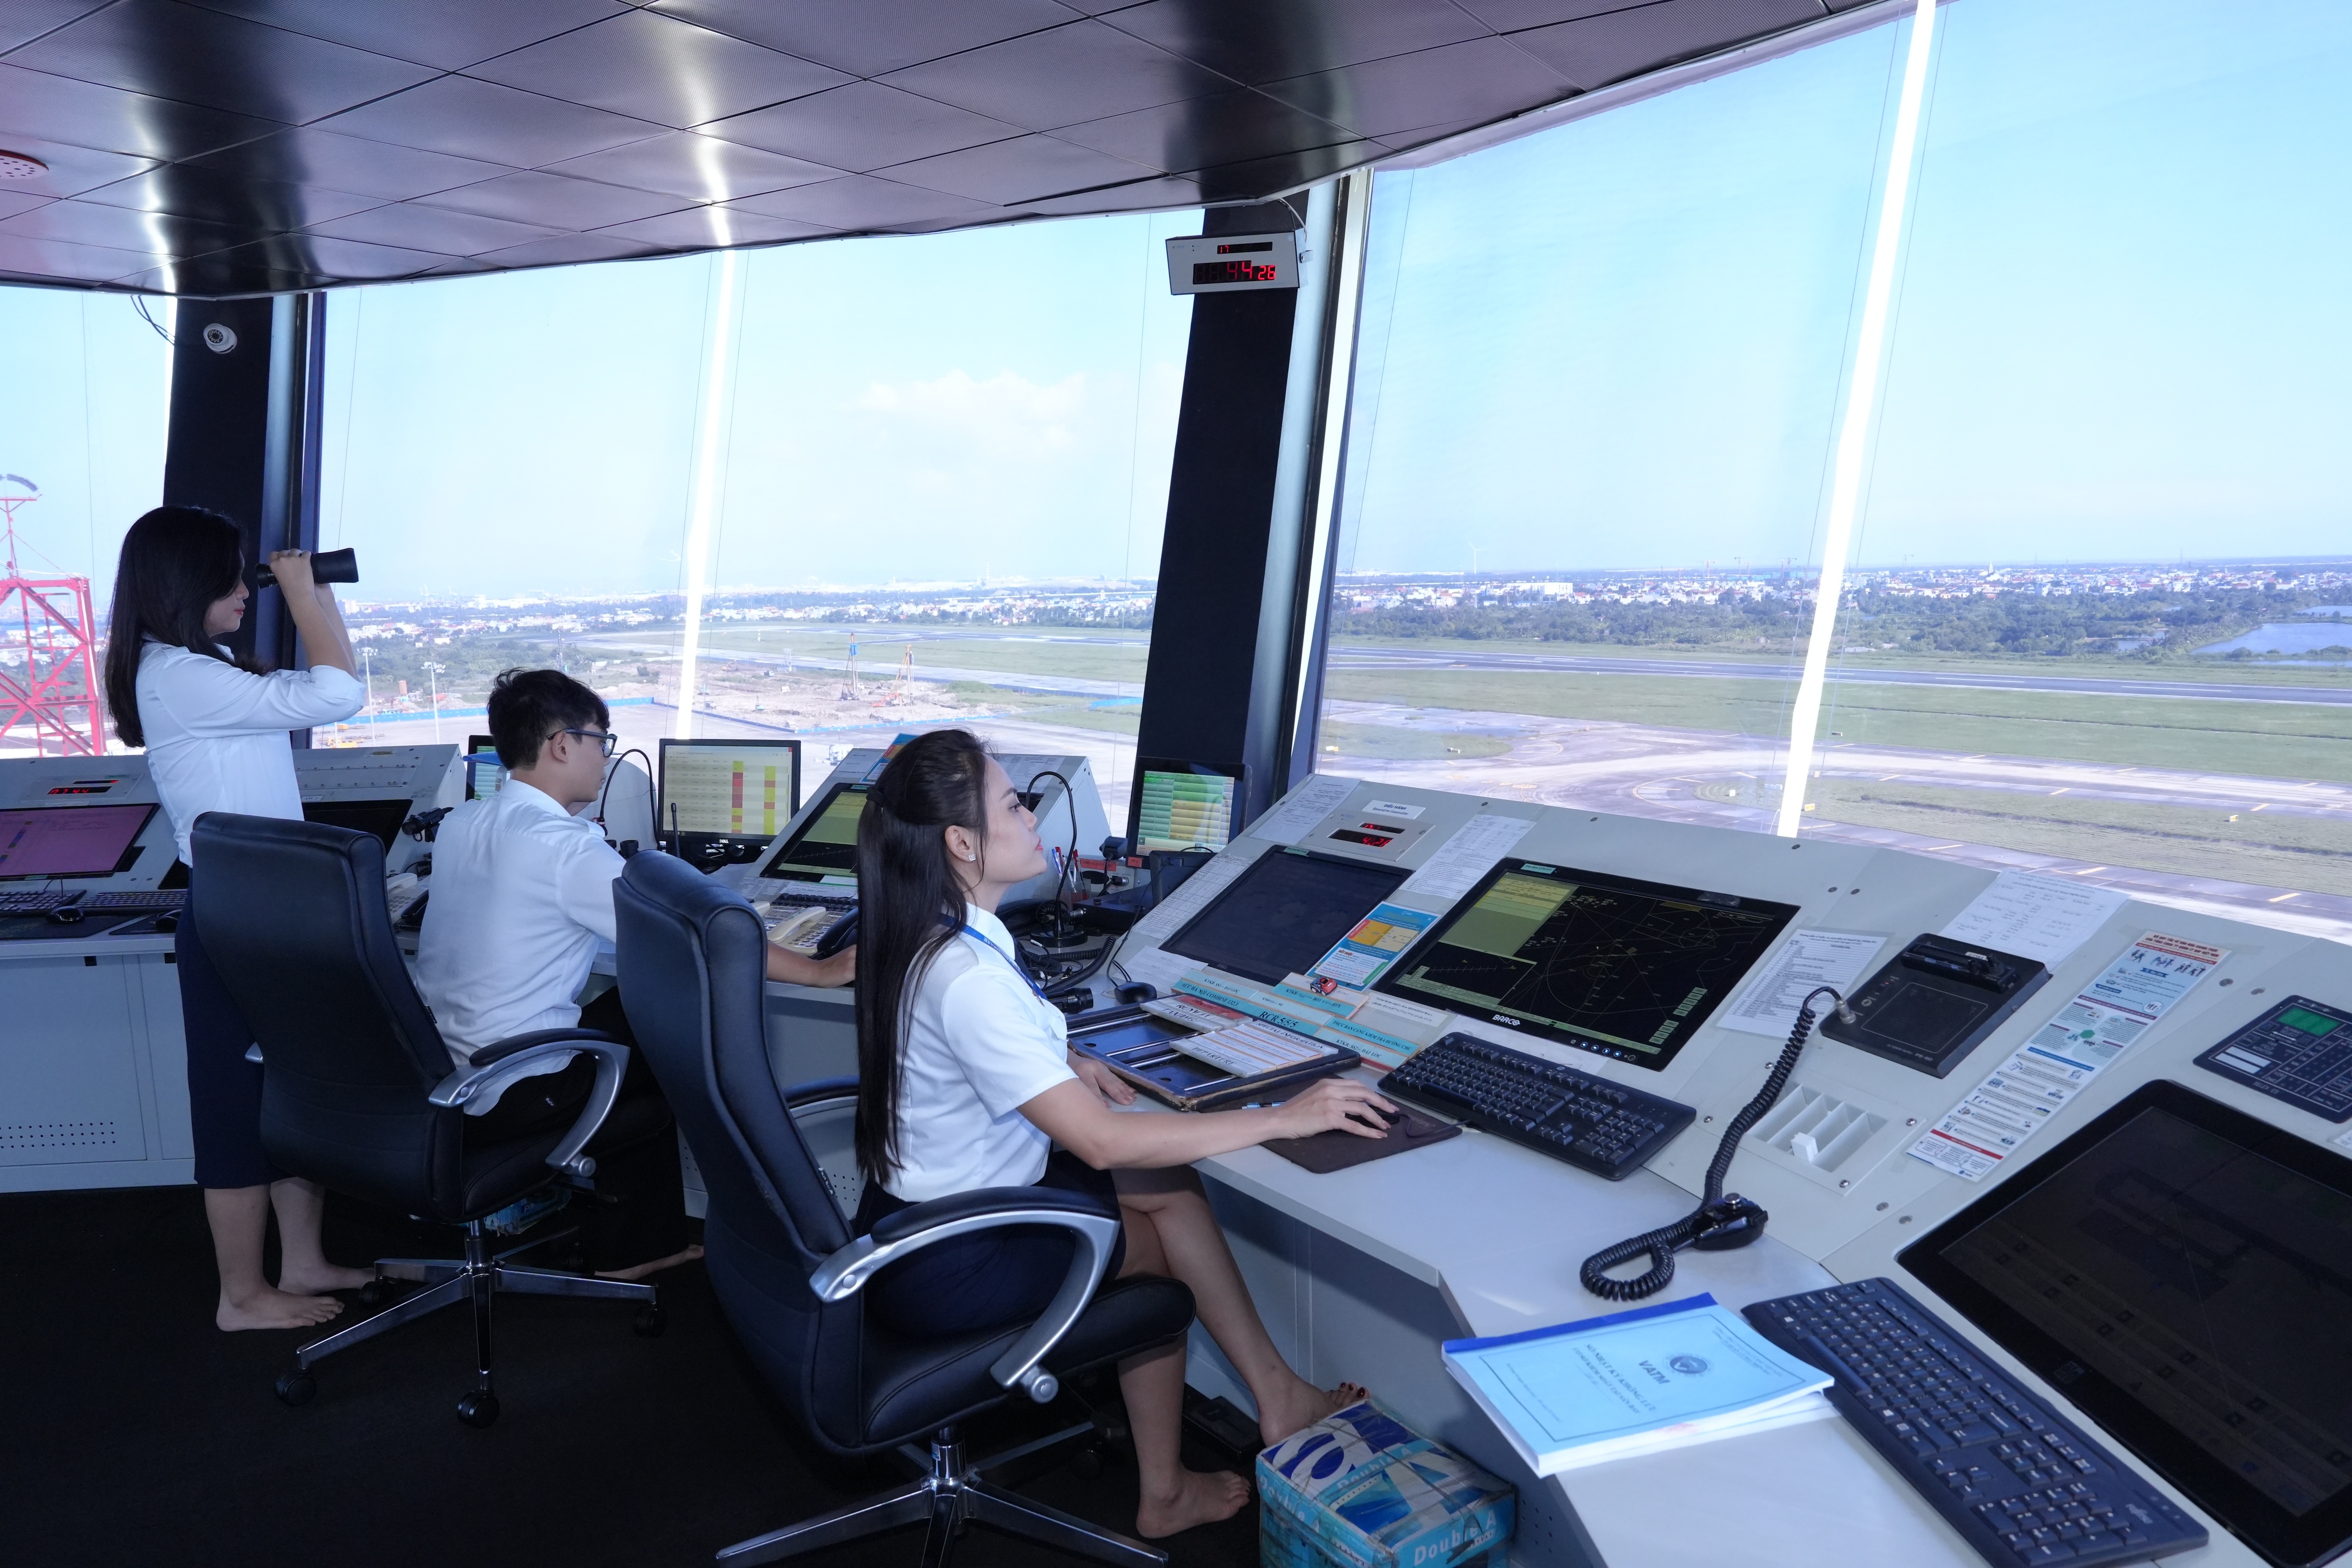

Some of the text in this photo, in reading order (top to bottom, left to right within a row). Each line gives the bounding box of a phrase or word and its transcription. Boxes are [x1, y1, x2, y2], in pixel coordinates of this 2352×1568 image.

[1354, 921, 1366, 933] LANDING
[1205, 991, 1228, 1002] COMBINE
[1259, 1011, 1299, 1028] RCR 5/5/5
[1492, 1014, 1521, 1026] BARCO
[1255, 1022, 1324, 1049] SPECIAL INFORMATION
[1192, 1047, 1236, 1065] DEPARTURE
[1638, 1360, 1670, 1384] VATM
[1486, 1510, 1497, 1530] A
